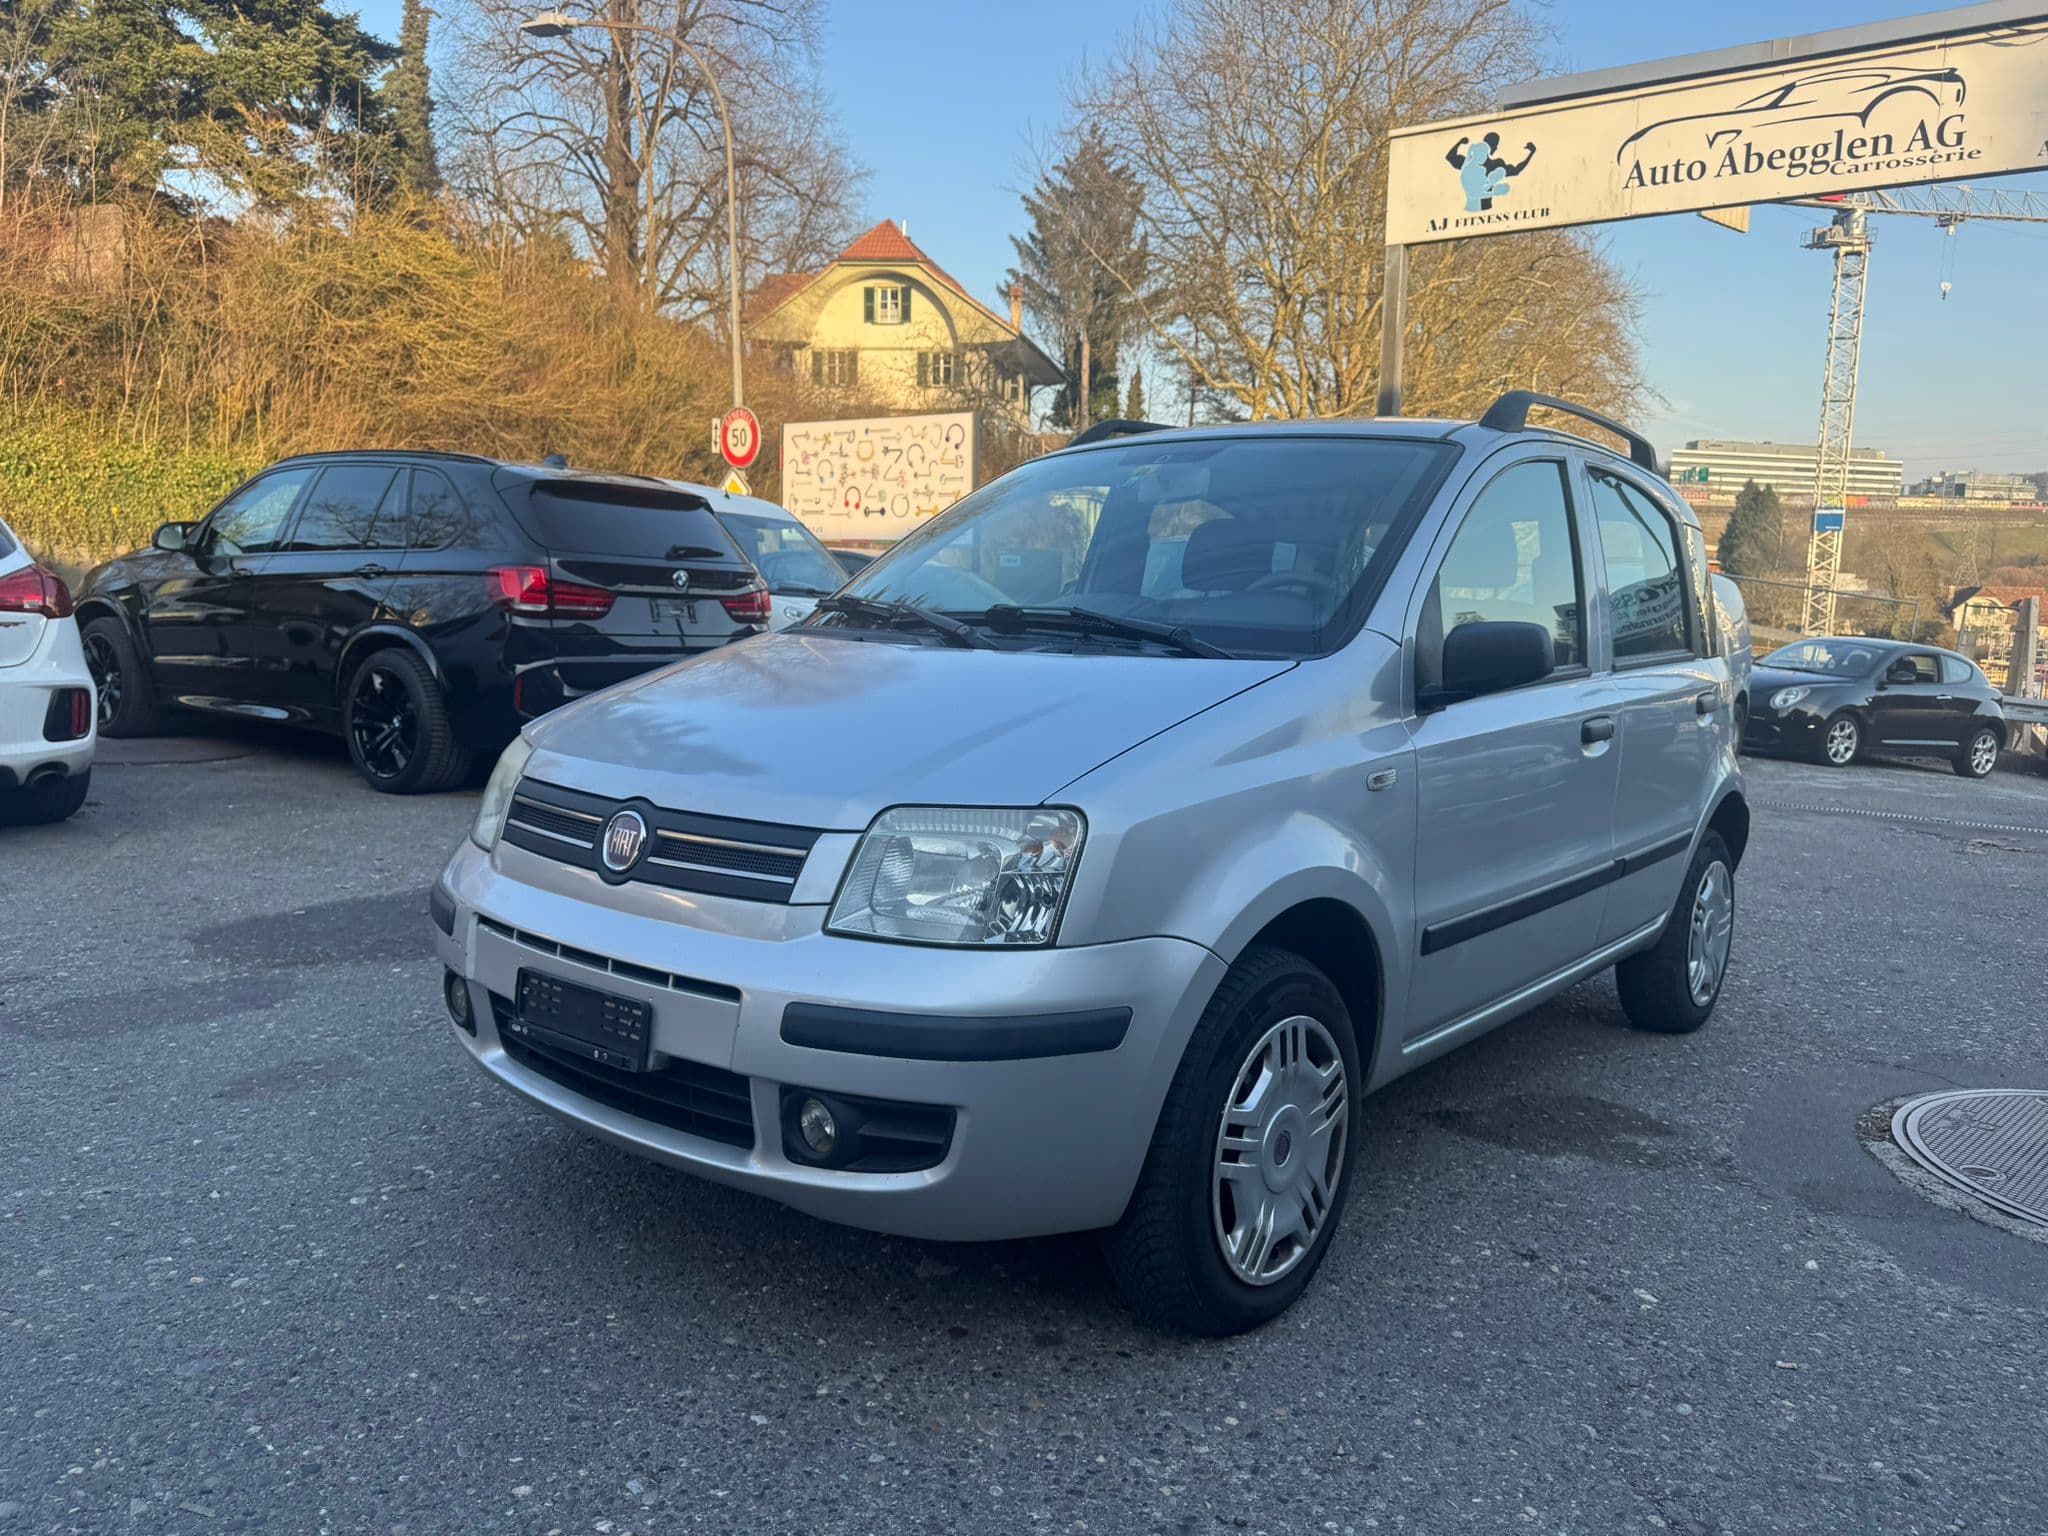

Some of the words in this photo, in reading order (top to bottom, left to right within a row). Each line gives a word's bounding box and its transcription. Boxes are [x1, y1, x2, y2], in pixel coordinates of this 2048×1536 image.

[1622, 159, 1707, 190] Auto
[1714, 129, 1894, 179] Abegglen
[1907, 114, 1967, 154] AG
[1830, 147, 1983, 177] Carrosserie
[1425, 217, 1448, 232] AJ
[1455, 211, 1510, 228] FITNESS
[1514, 207, 1551, 221] CLUB
[732, 429, 747, 448] 50
[610, 827, 637, 856] FIAT
